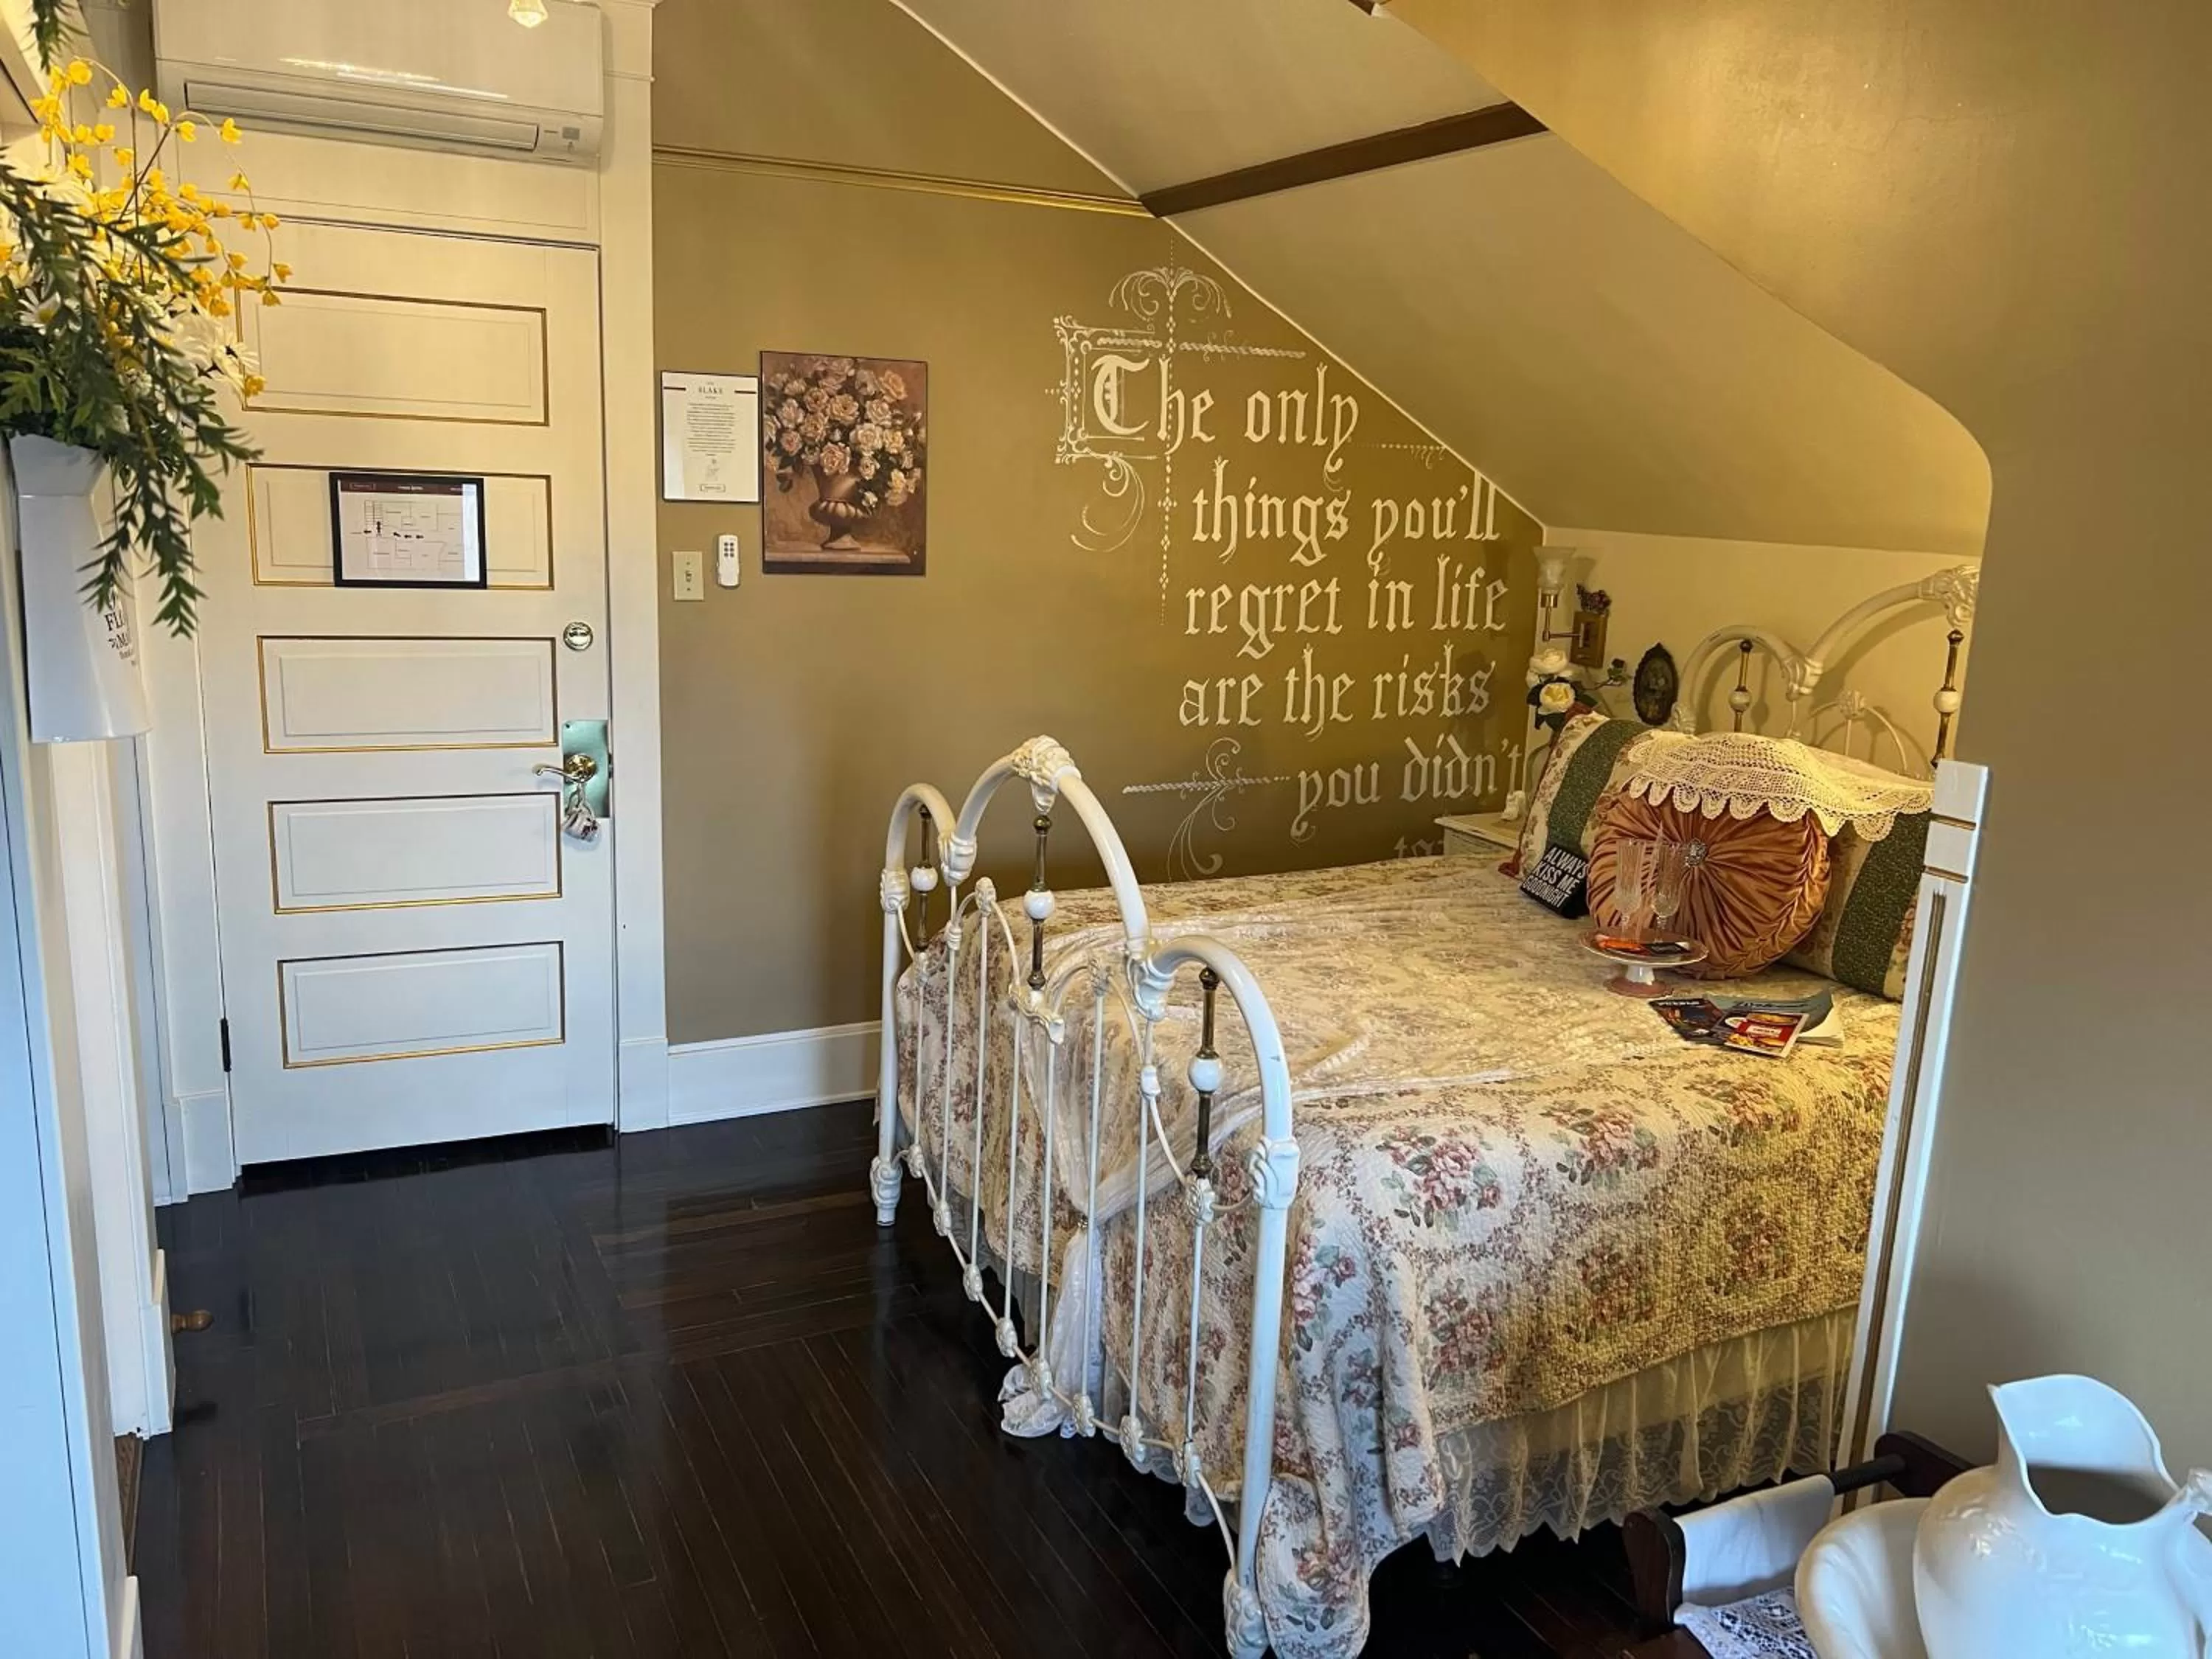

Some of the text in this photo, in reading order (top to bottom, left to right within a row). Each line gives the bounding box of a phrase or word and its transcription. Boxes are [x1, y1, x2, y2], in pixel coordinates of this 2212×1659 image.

[1091, 353, 1359, 473] The only
[1192, 456, 1500, 567] things you'll
[1185, 554, 1509, 660] regret in life
[1179, 639, 1497, 742] are the risks
[1290, 734, 1523, 844] you didn't
[1523, 874, 1570, 908] GOODNIGHT
[1533, 861, 1580, 894] KISS ME
[1543, 846, 1589, 880] ALWAYS
